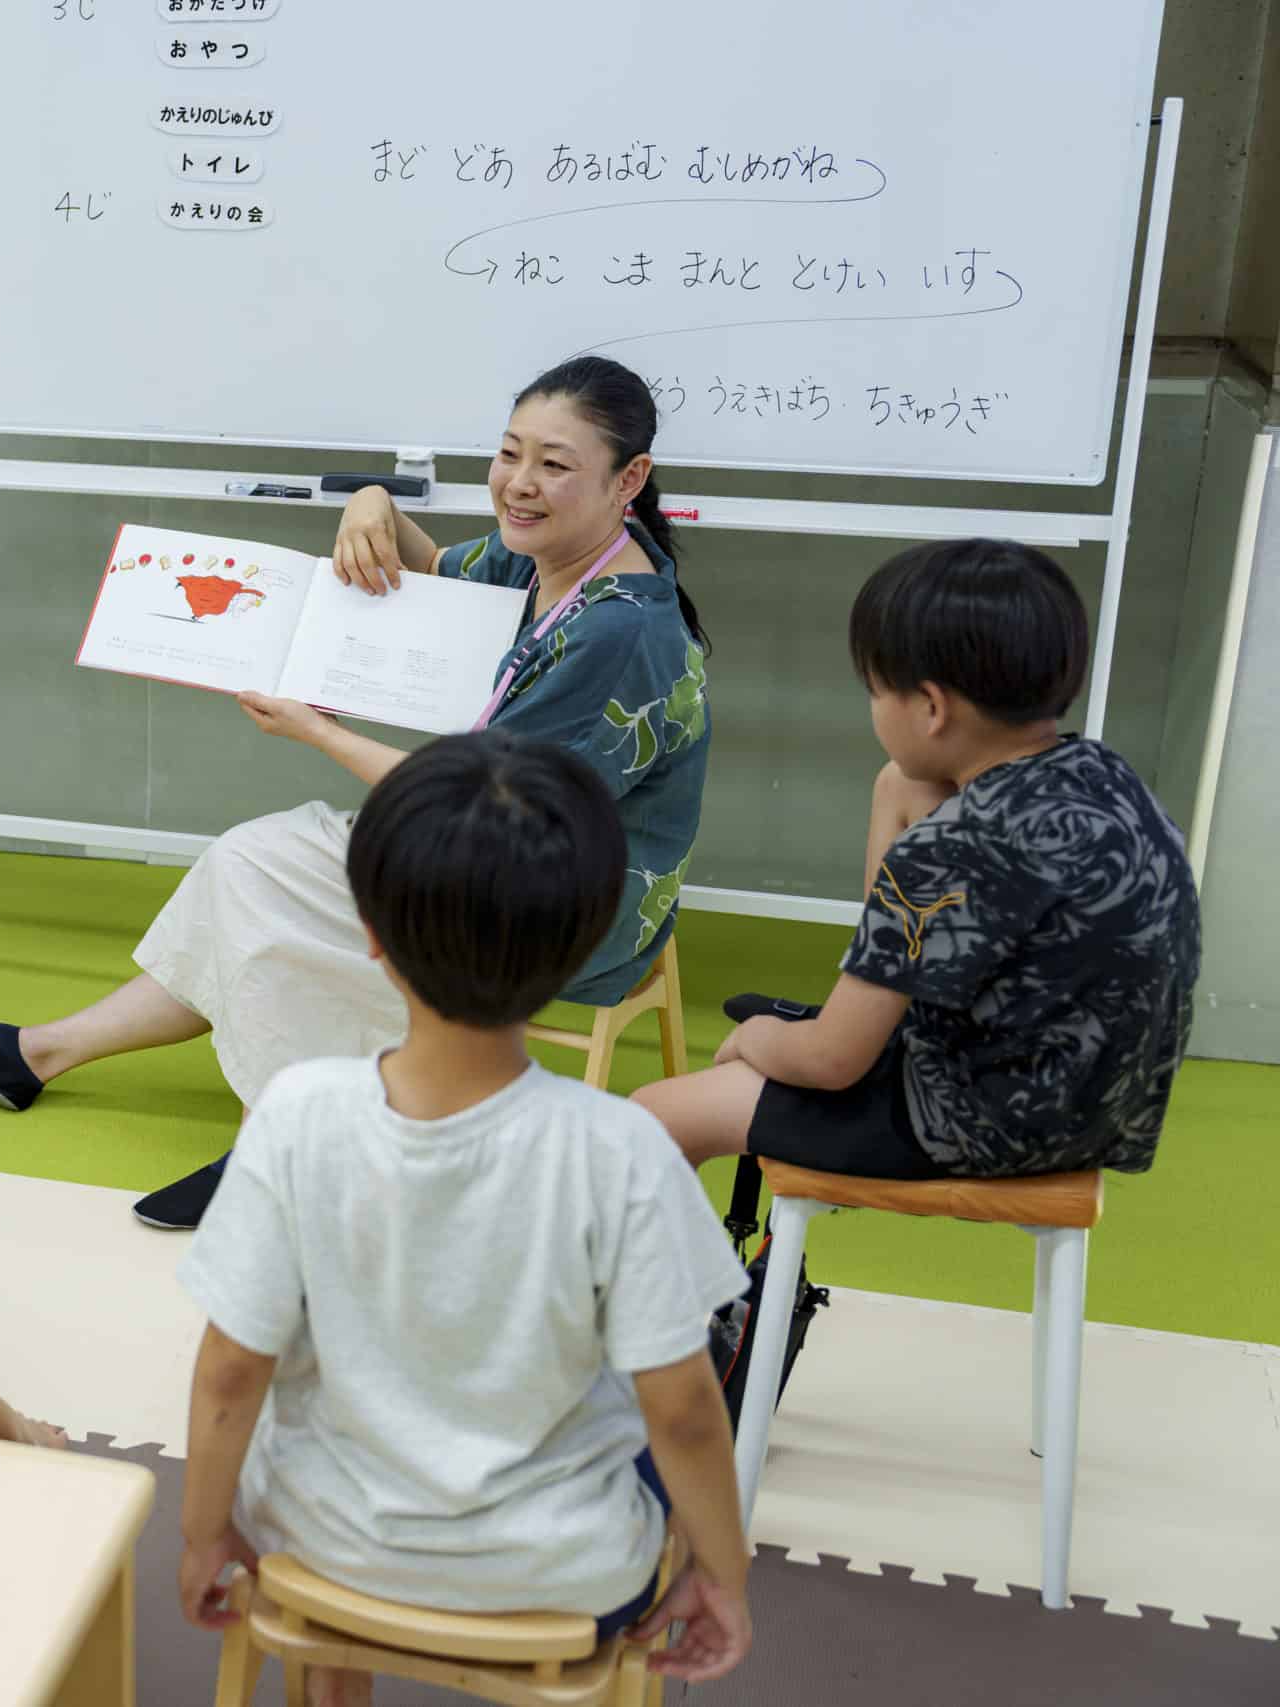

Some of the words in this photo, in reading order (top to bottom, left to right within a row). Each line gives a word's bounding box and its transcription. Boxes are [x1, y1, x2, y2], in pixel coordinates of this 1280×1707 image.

[169, 39, 249, 60] おやつ
[158, 105, 274, 127] かえりのじゅんび
[182, 153, 251, 175] トイレ
[370, 138, 427, 183] まど
[453, 143, 513, 189] どあ
[546, 139, 667, 184] あるばむ
[687, 145, 839, 184] むしめがね
[54, 191, 112, 223] 4じ
[169, 201, 264, 224] かえりの会
[514, 250, 565, 286] ねこ
[602, 251, 654, 286] こま
[679, 250, 762, 291] まんと
[791, 253, 887, 294] とけい
[922, 247, 993, 296] いす
[707, 375, 830, 421] うえきばち
[865, 385, 1010, 434] ちきゅうぎ
